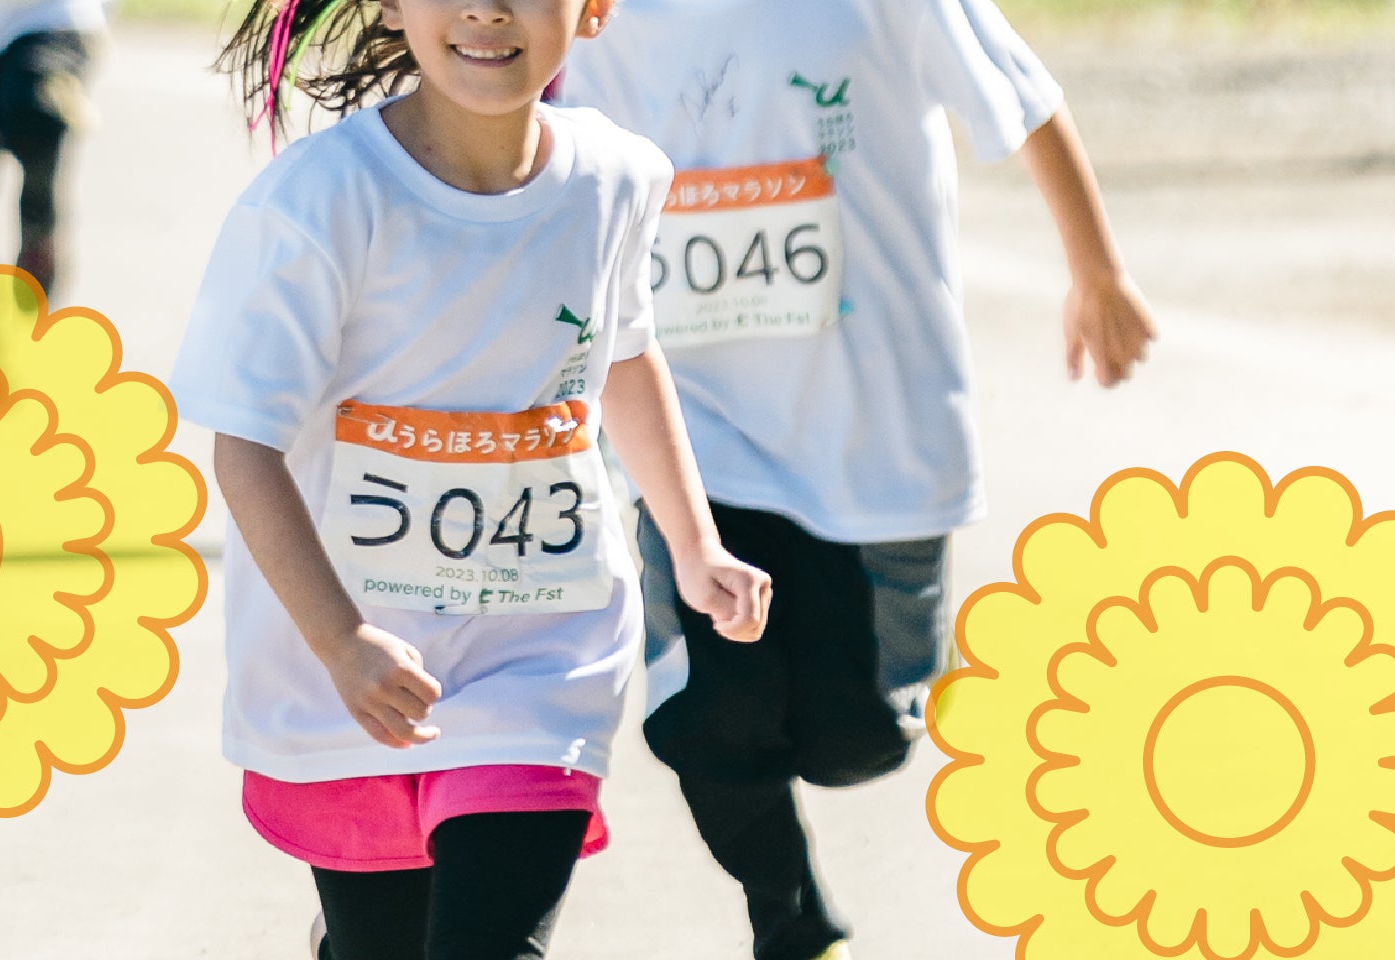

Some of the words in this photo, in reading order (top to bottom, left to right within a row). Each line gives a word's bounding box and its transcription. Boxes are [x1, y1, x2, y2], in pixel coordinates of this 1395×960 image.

[435, 566, 519, 583] 2023.10.08
[363, 578, 445, 599] powered
[450, 586, 472, 605] by
[498, 590, 531, 604] The
[535, 587, 565, 601] Fst
